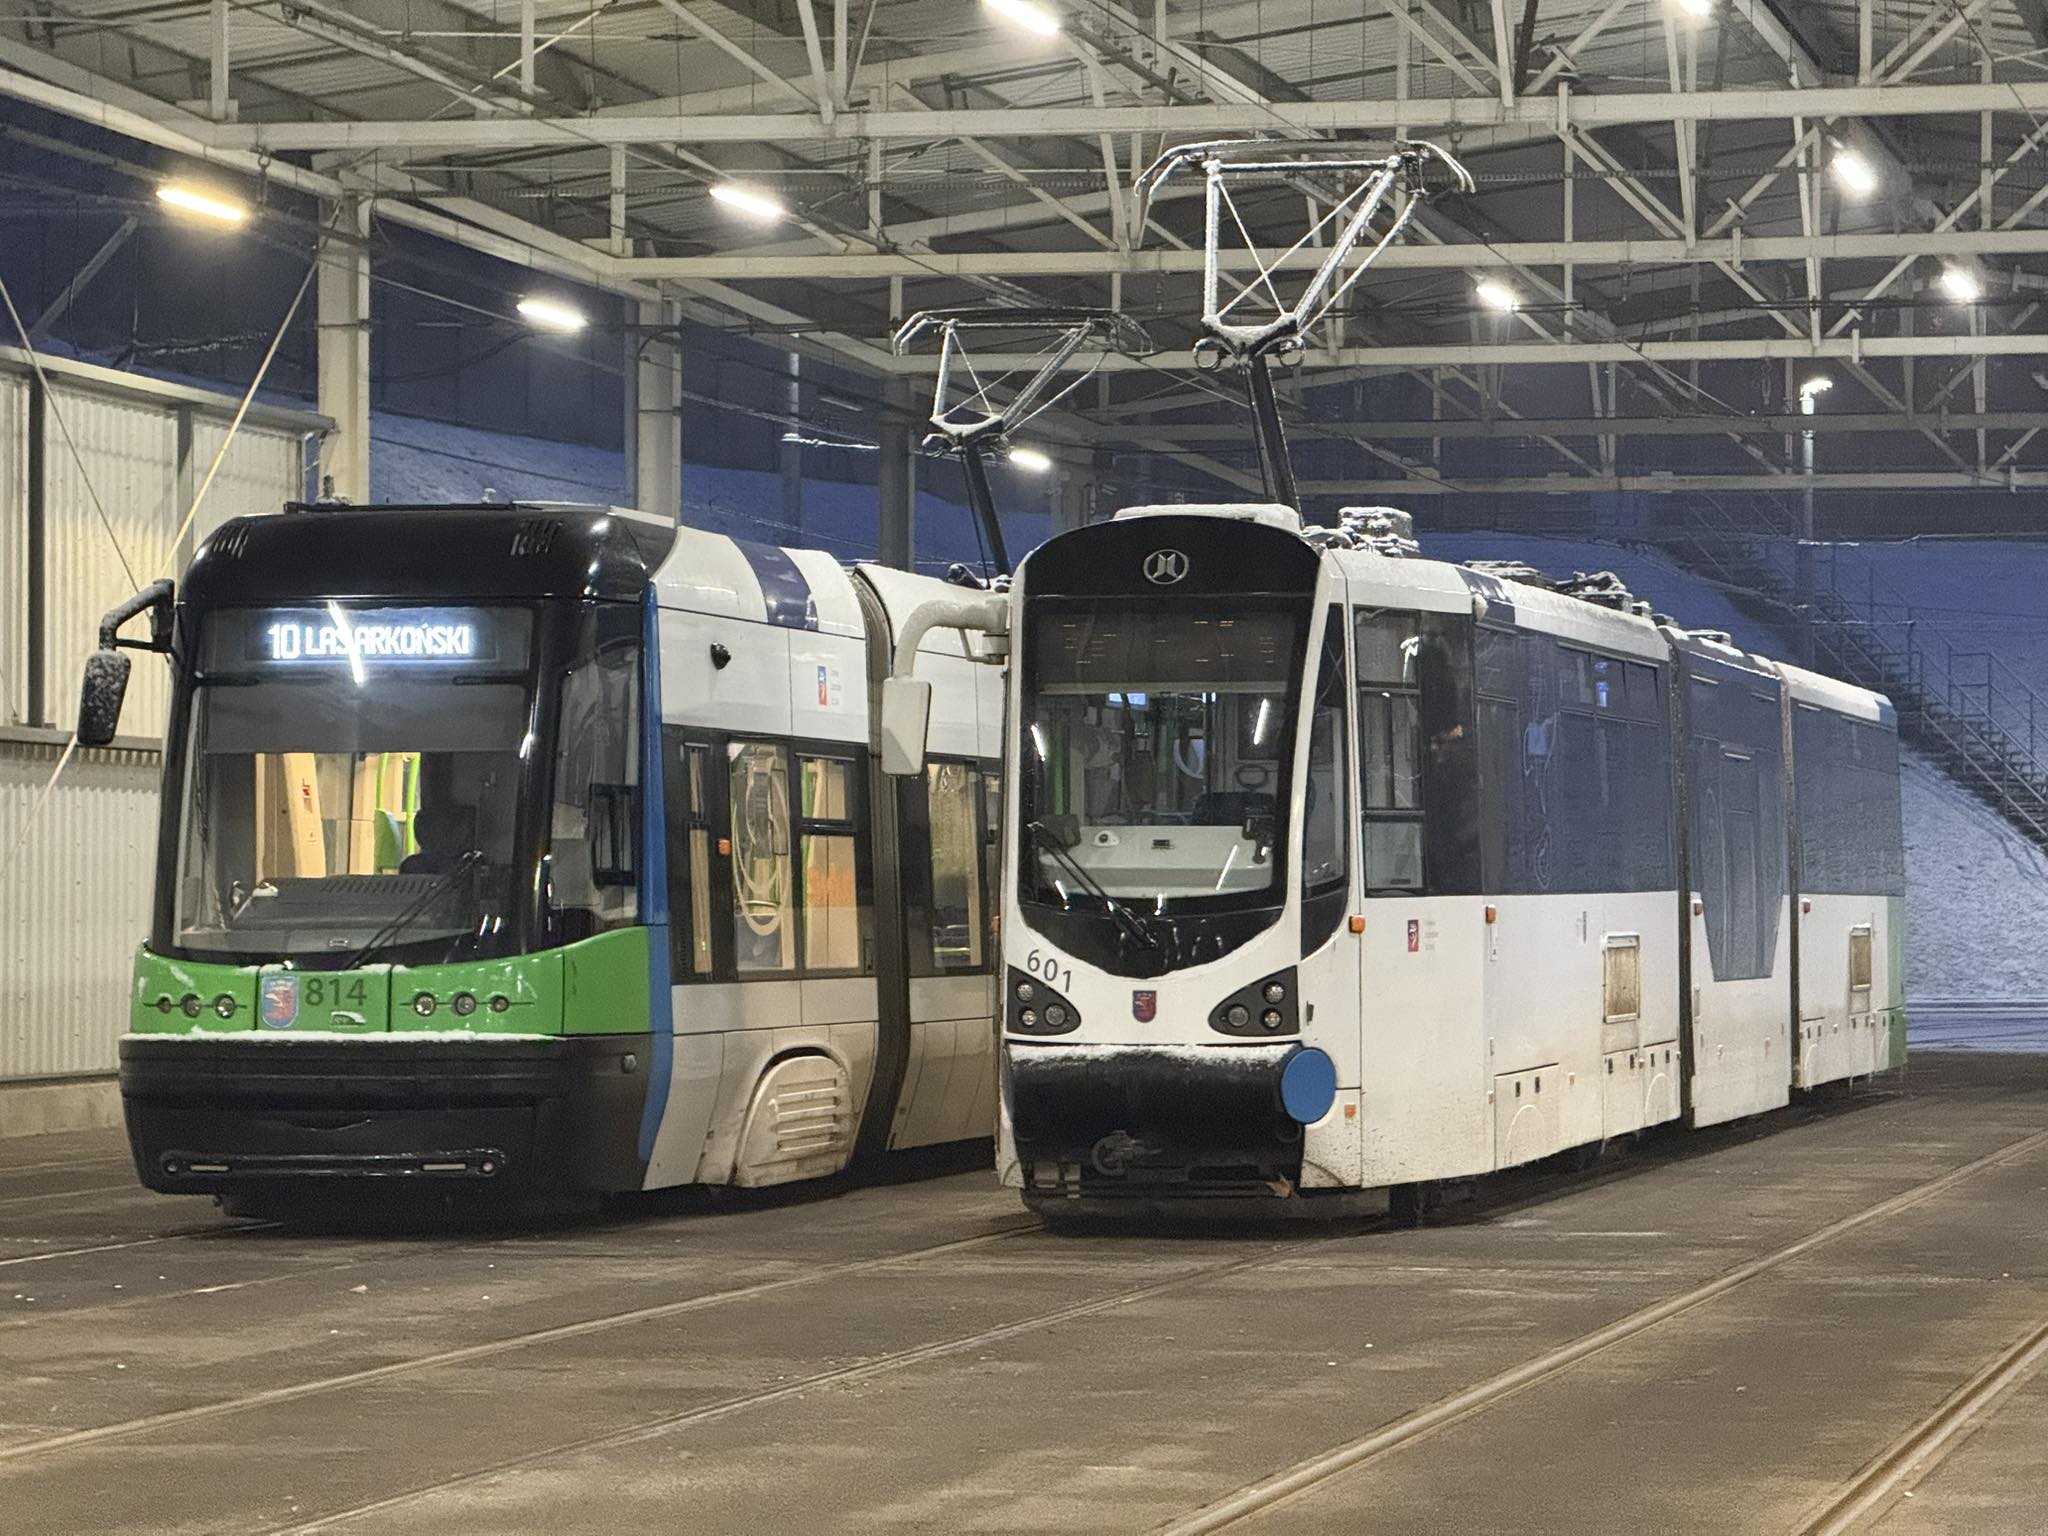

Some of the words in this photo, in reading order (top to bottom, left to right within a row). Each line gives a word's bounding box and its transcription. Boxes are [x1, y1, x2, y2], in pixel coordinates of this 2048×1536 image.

[268, 624, 301, 660] 10
[353, 622, 471, 656] ARKOŃSKI
[1027, 949, 1071, 993] 601
[305, 978, 367, 1006] 814
